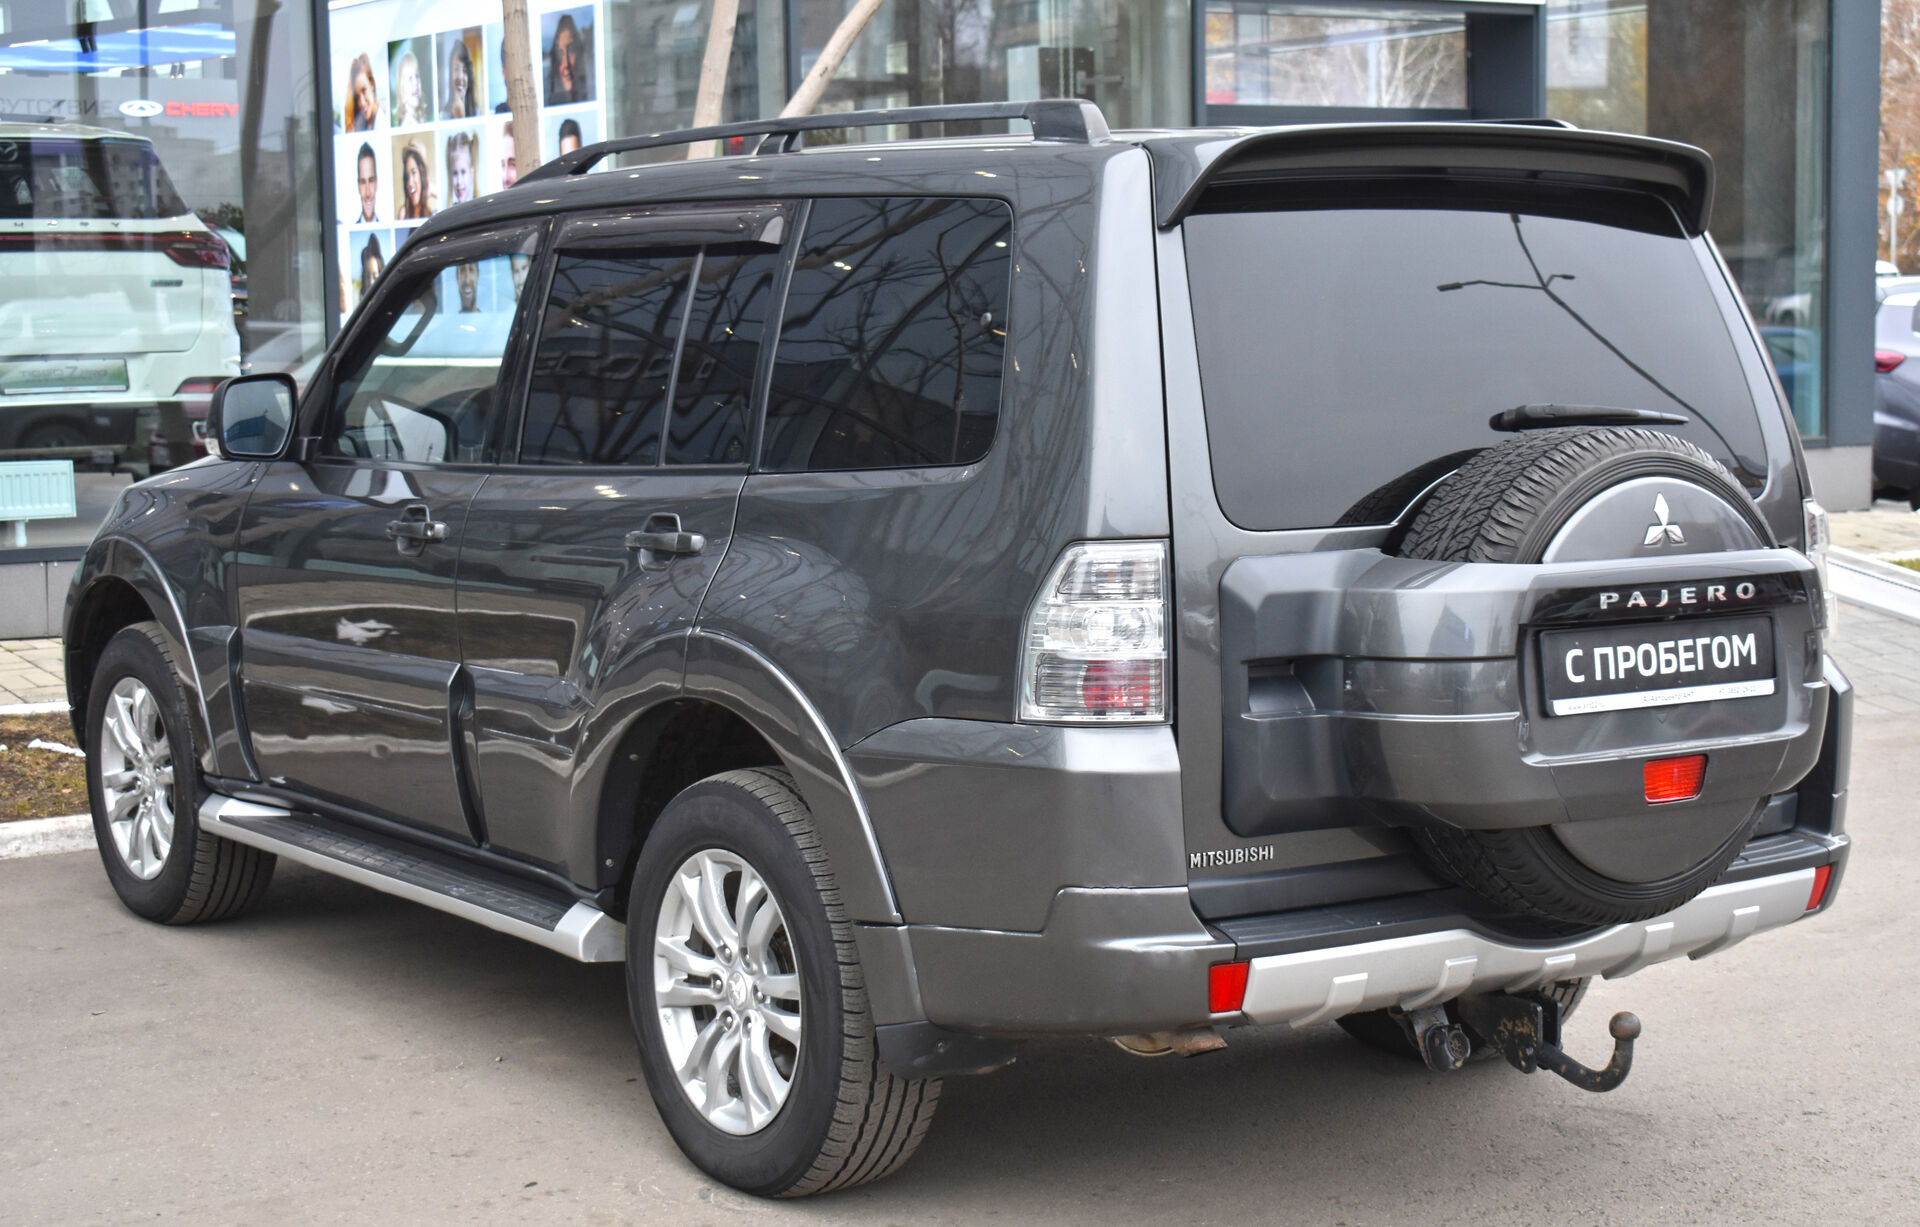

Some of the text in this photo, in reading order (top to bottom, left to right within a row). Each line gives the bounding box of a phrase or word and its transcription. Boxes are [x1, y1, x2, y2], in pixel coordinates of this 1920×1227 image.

[165, 101, 240, 117] CHERY
[1600, 582, 1756, 610] PAJERO
[1565, 633, 1757, 683] С ПРОБЕГОМ
[1190, 845, 1274, 869] MITSUBISHI
